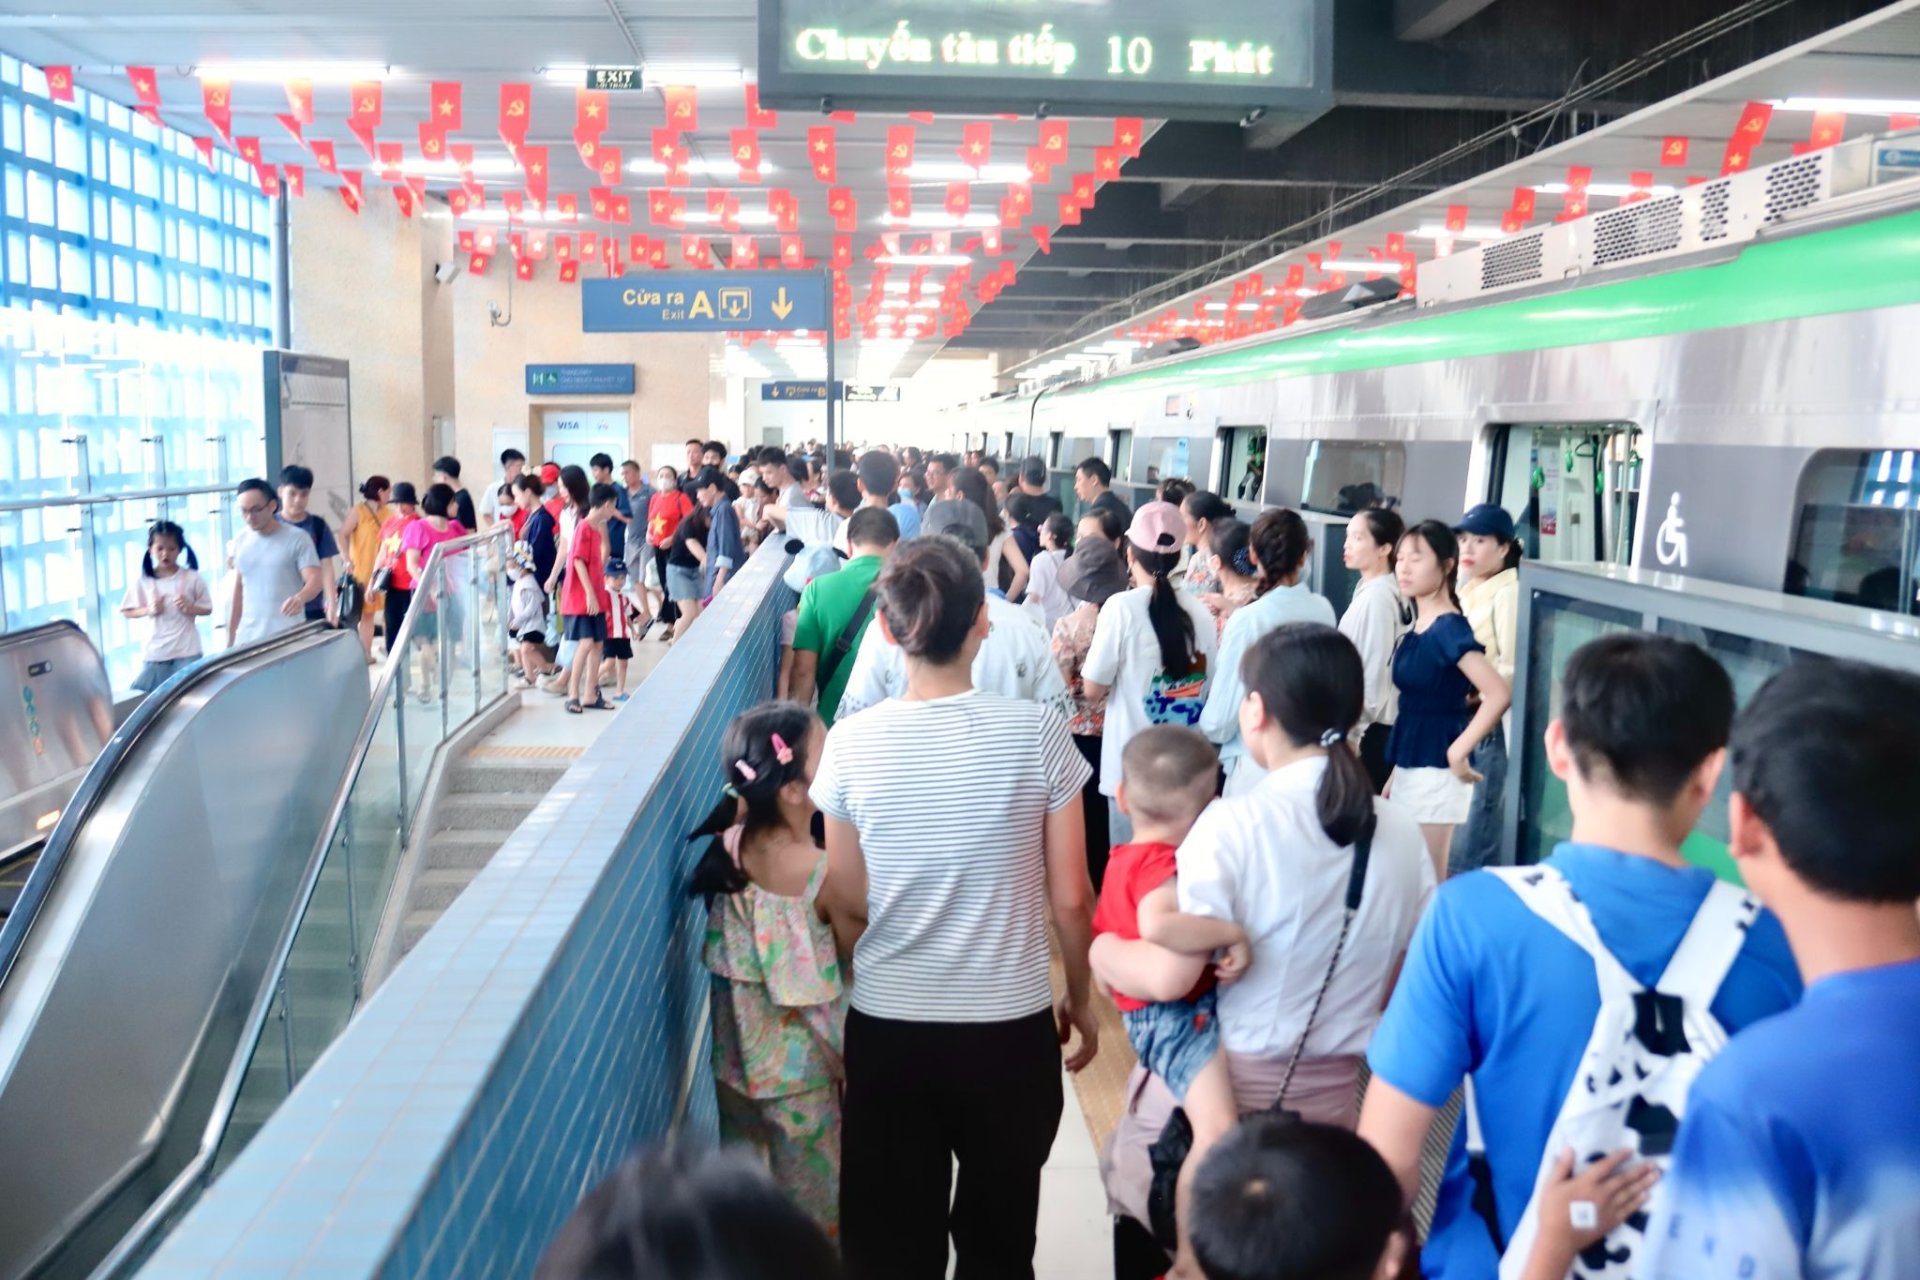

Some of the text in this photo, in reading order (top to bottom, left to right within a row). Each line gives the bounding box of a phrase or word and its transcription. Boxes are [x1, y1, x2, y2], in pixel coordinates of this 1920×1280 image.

[796, 20, 932, 70] Chuyến
[1008, 23, 1076, 74] tiếp
[1107, 36, 1152, 73] 10
[1189, 40, 1273, 74] Phát
[596, 70, 633, 82] EXIT
[623, 288, 714, 319] Cửa ra A
[662, 309, 684, 320] Exit
[557, 421, 579, 430] VISA
